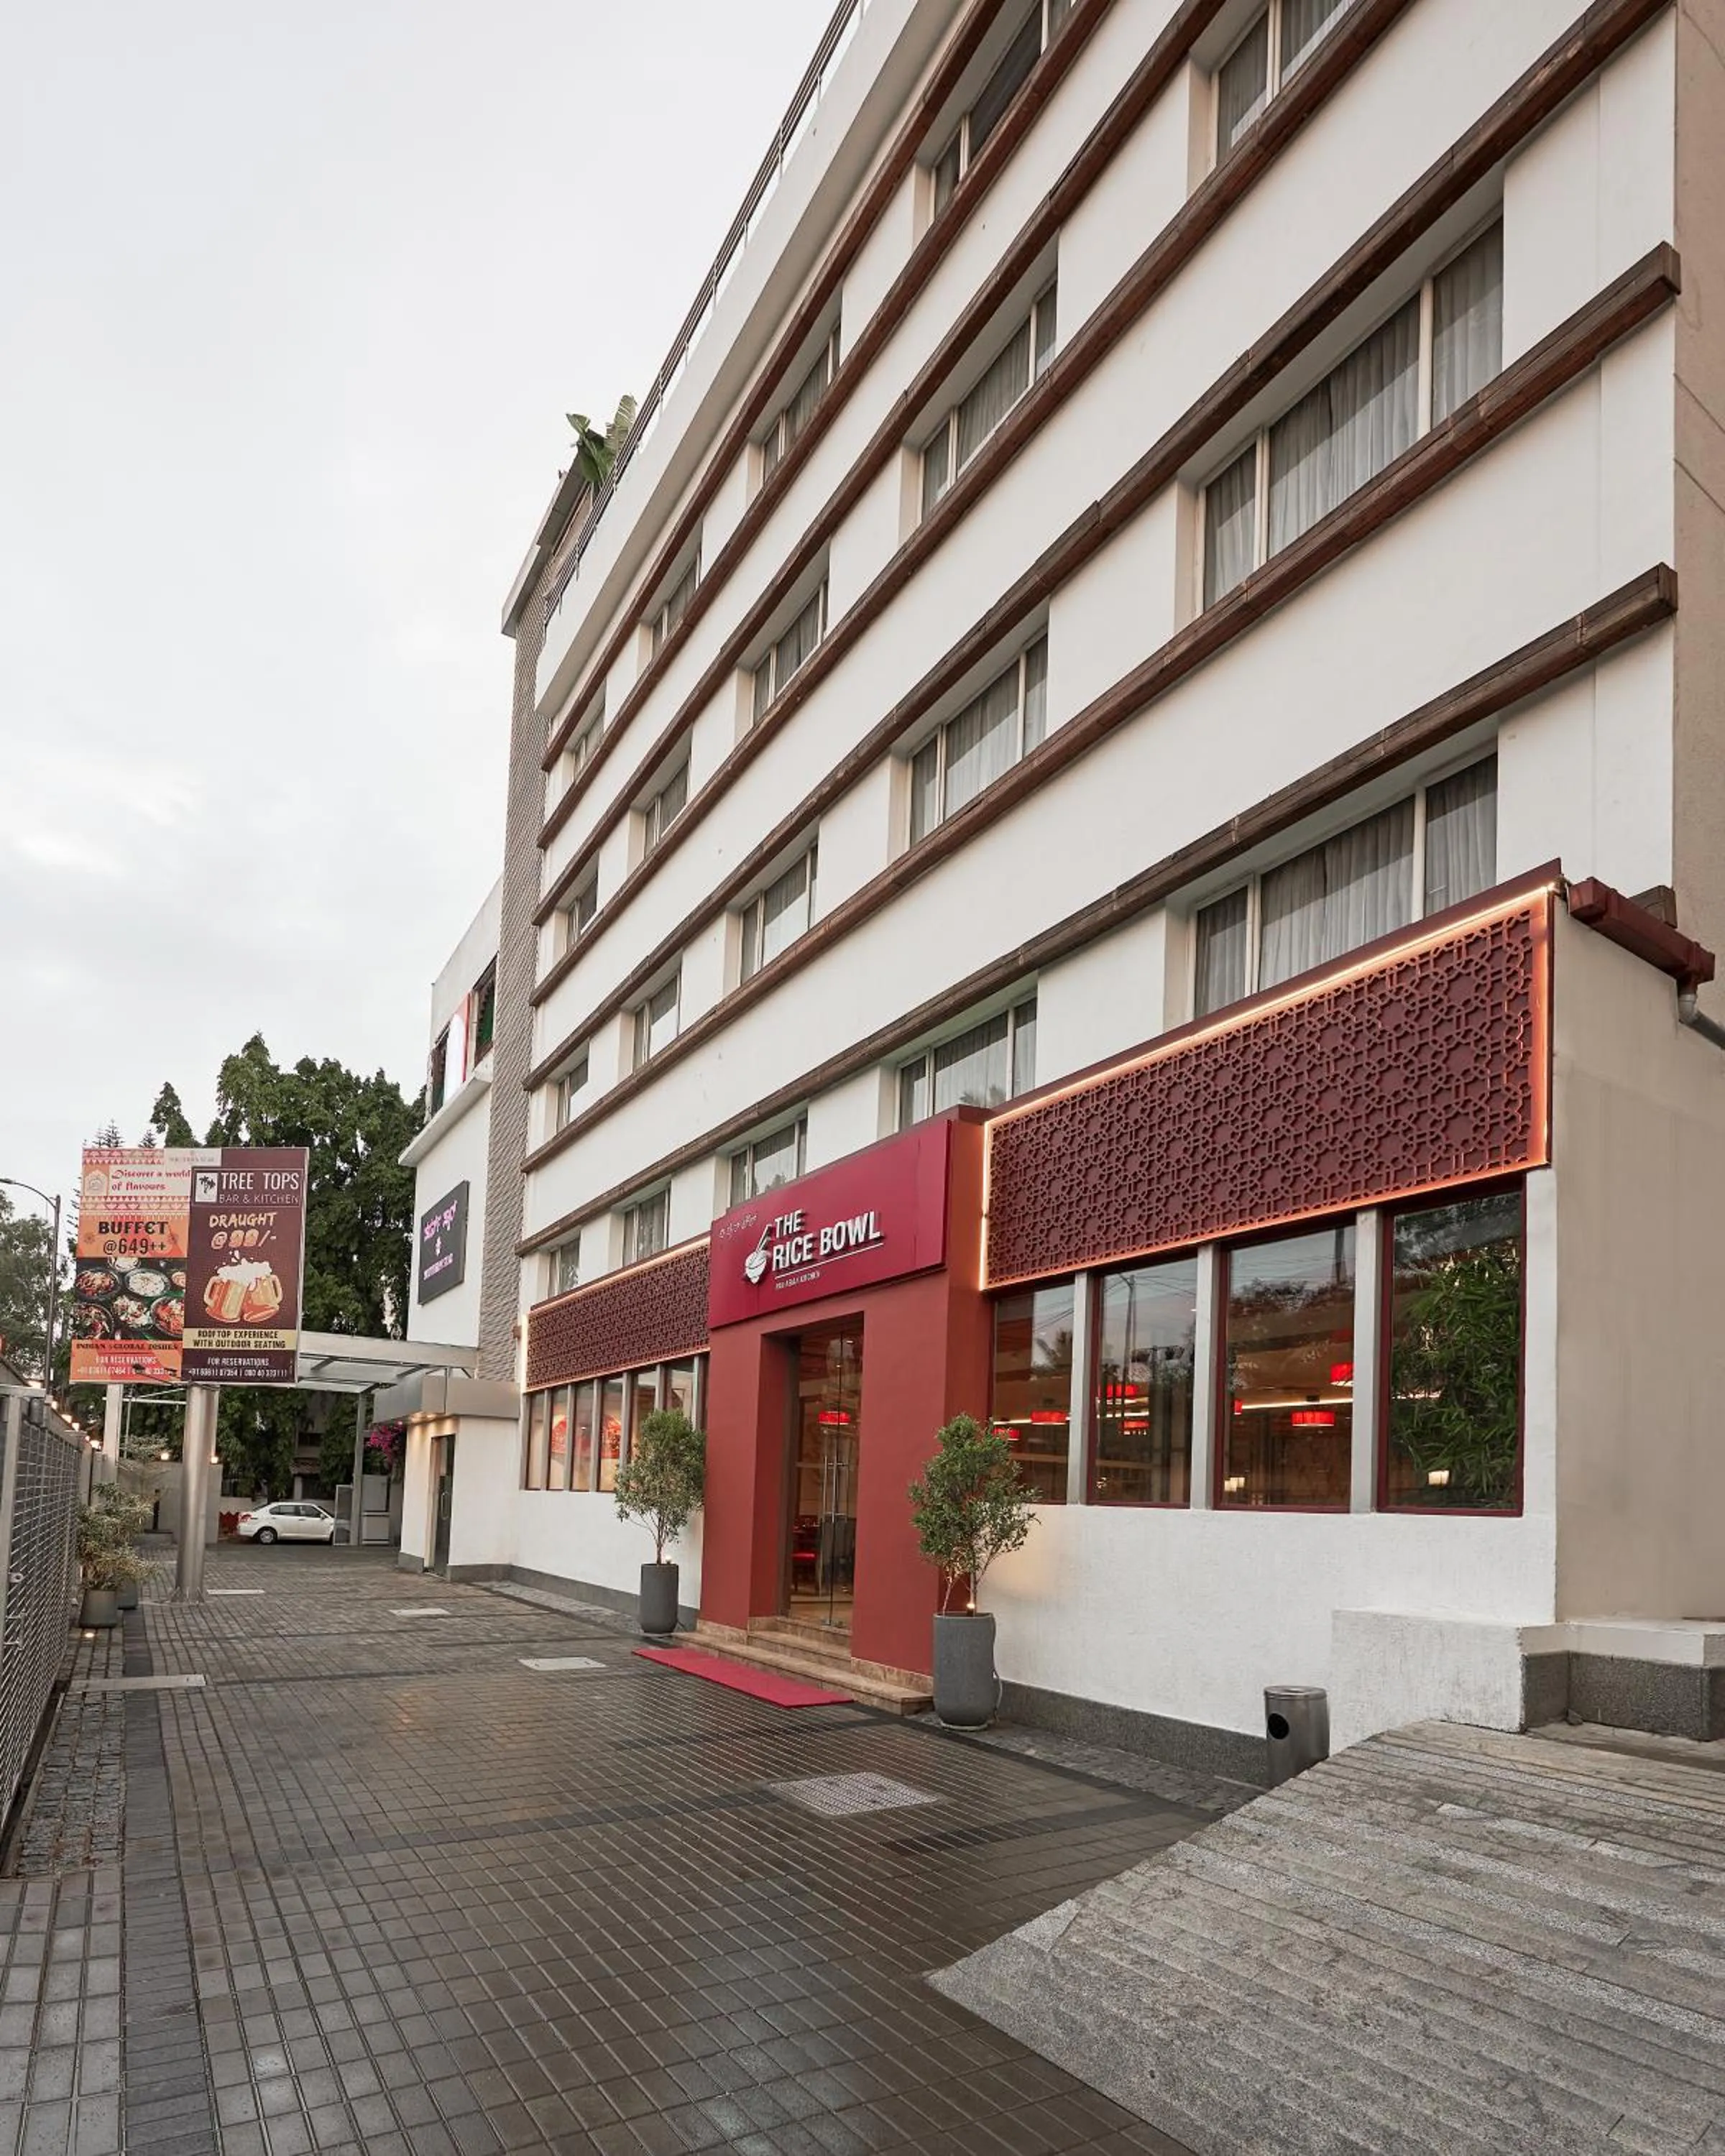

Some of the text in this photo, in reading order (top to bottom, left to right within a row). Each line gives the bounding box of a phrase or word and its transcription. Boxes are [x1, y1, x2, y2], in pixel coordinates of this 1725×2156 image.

[111, 1170, 156, 1179] Discover
[165, 1169, 190, 1178] world
[221, 1172, 300, 1189] TREE TOPS
[111, 1181, 166, 1191] of flavours
[219, 1193, 299, 1204] BAR & KITCHEN
[209, 1212, 277, 1228] DRAUGHT
[775, 1209, 804, 1238] THE
[98, 1222, 169, 1235] BUFFET
[772, 1211, 881, 1271] RICE BOWL
[254, 1340, 286, 1349] SEATING
